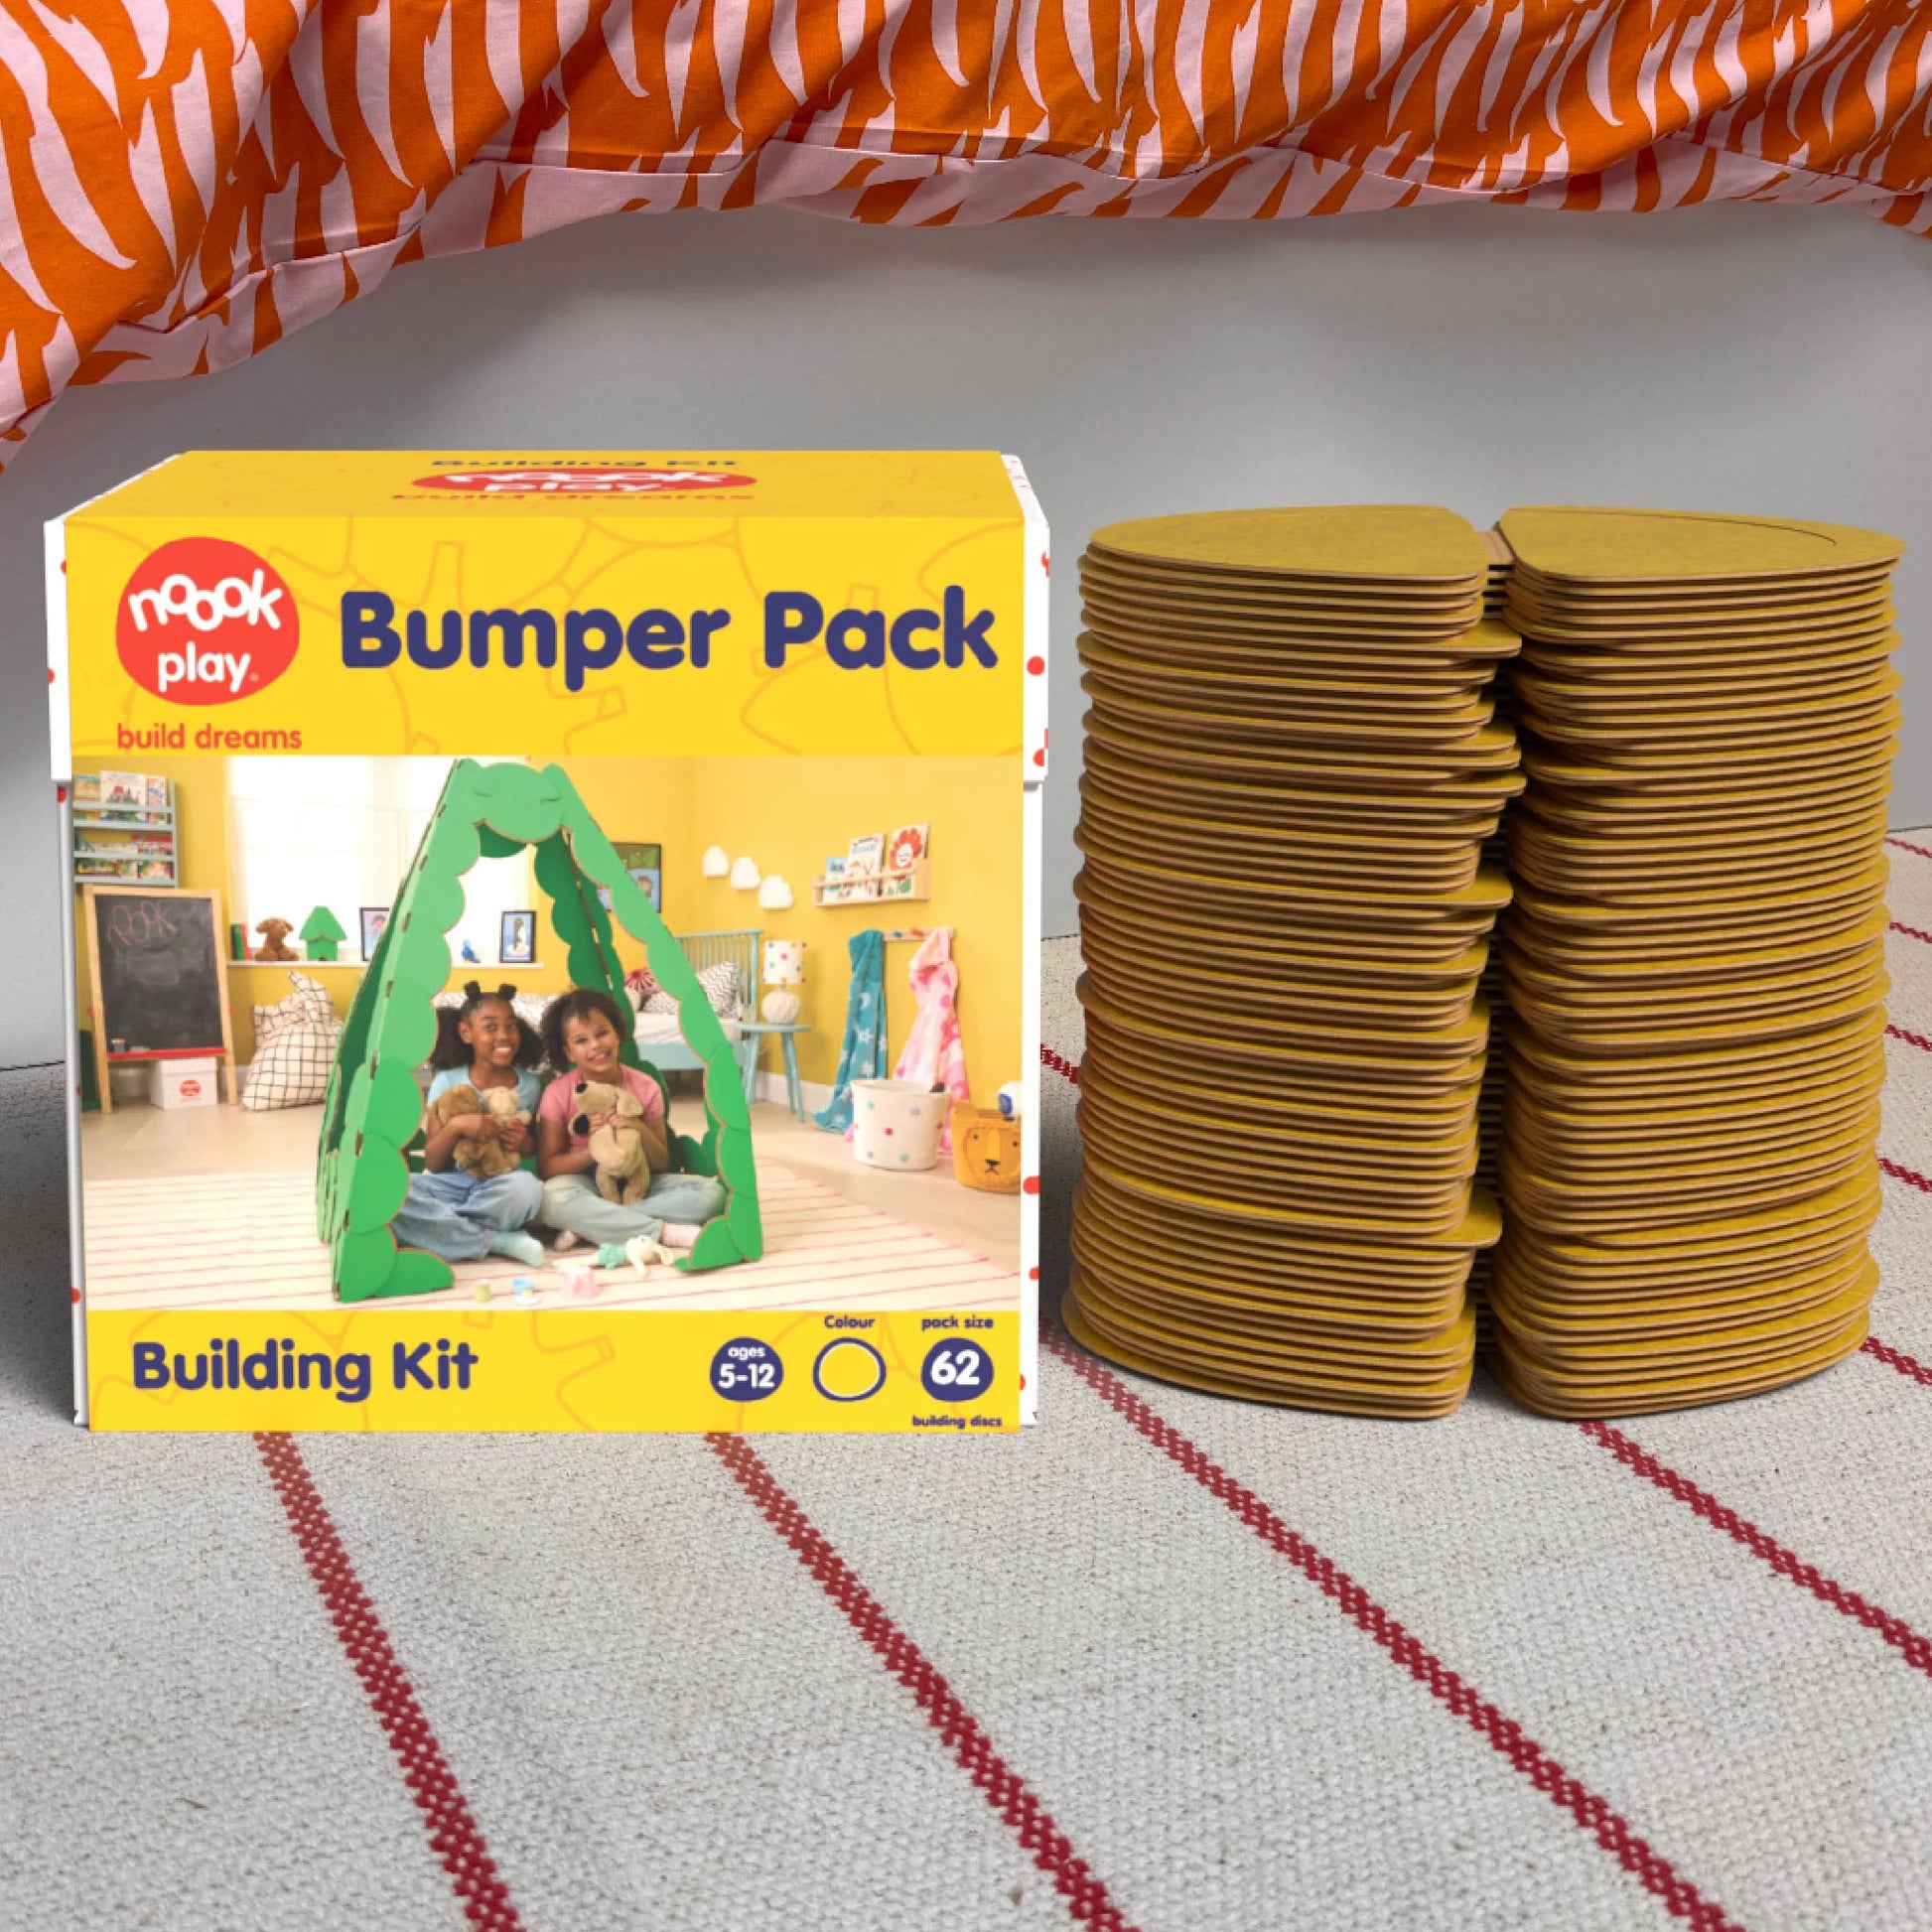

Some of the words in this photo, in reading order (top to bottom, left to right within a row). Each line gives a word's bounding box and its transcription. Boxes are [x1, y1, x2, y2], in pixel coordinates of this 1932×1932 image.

[341, 590, 731, 692] Bumper
[763, 585, 999, 670] Pack
[158, 640, 251, 693] play
[117, 723, 185, 749] build
[195, 723, 302, 749] dreams
[824, 1314, 876, 1328] Colour
[921, 1315, 959, 1331] pack
[964, 1314, 994, 1328] size
[728, 1346, 765, 1361] ages
[133, 1337, 371, 1403] Building
[392, 1337, 480, 1390] Kit
[718, 1363, 775, 1389] 5-12
[929, 1348, 981, 1386] 62
[912, 1415, 966, 1430] building
[970, 1415, 1003, 1428] discs
